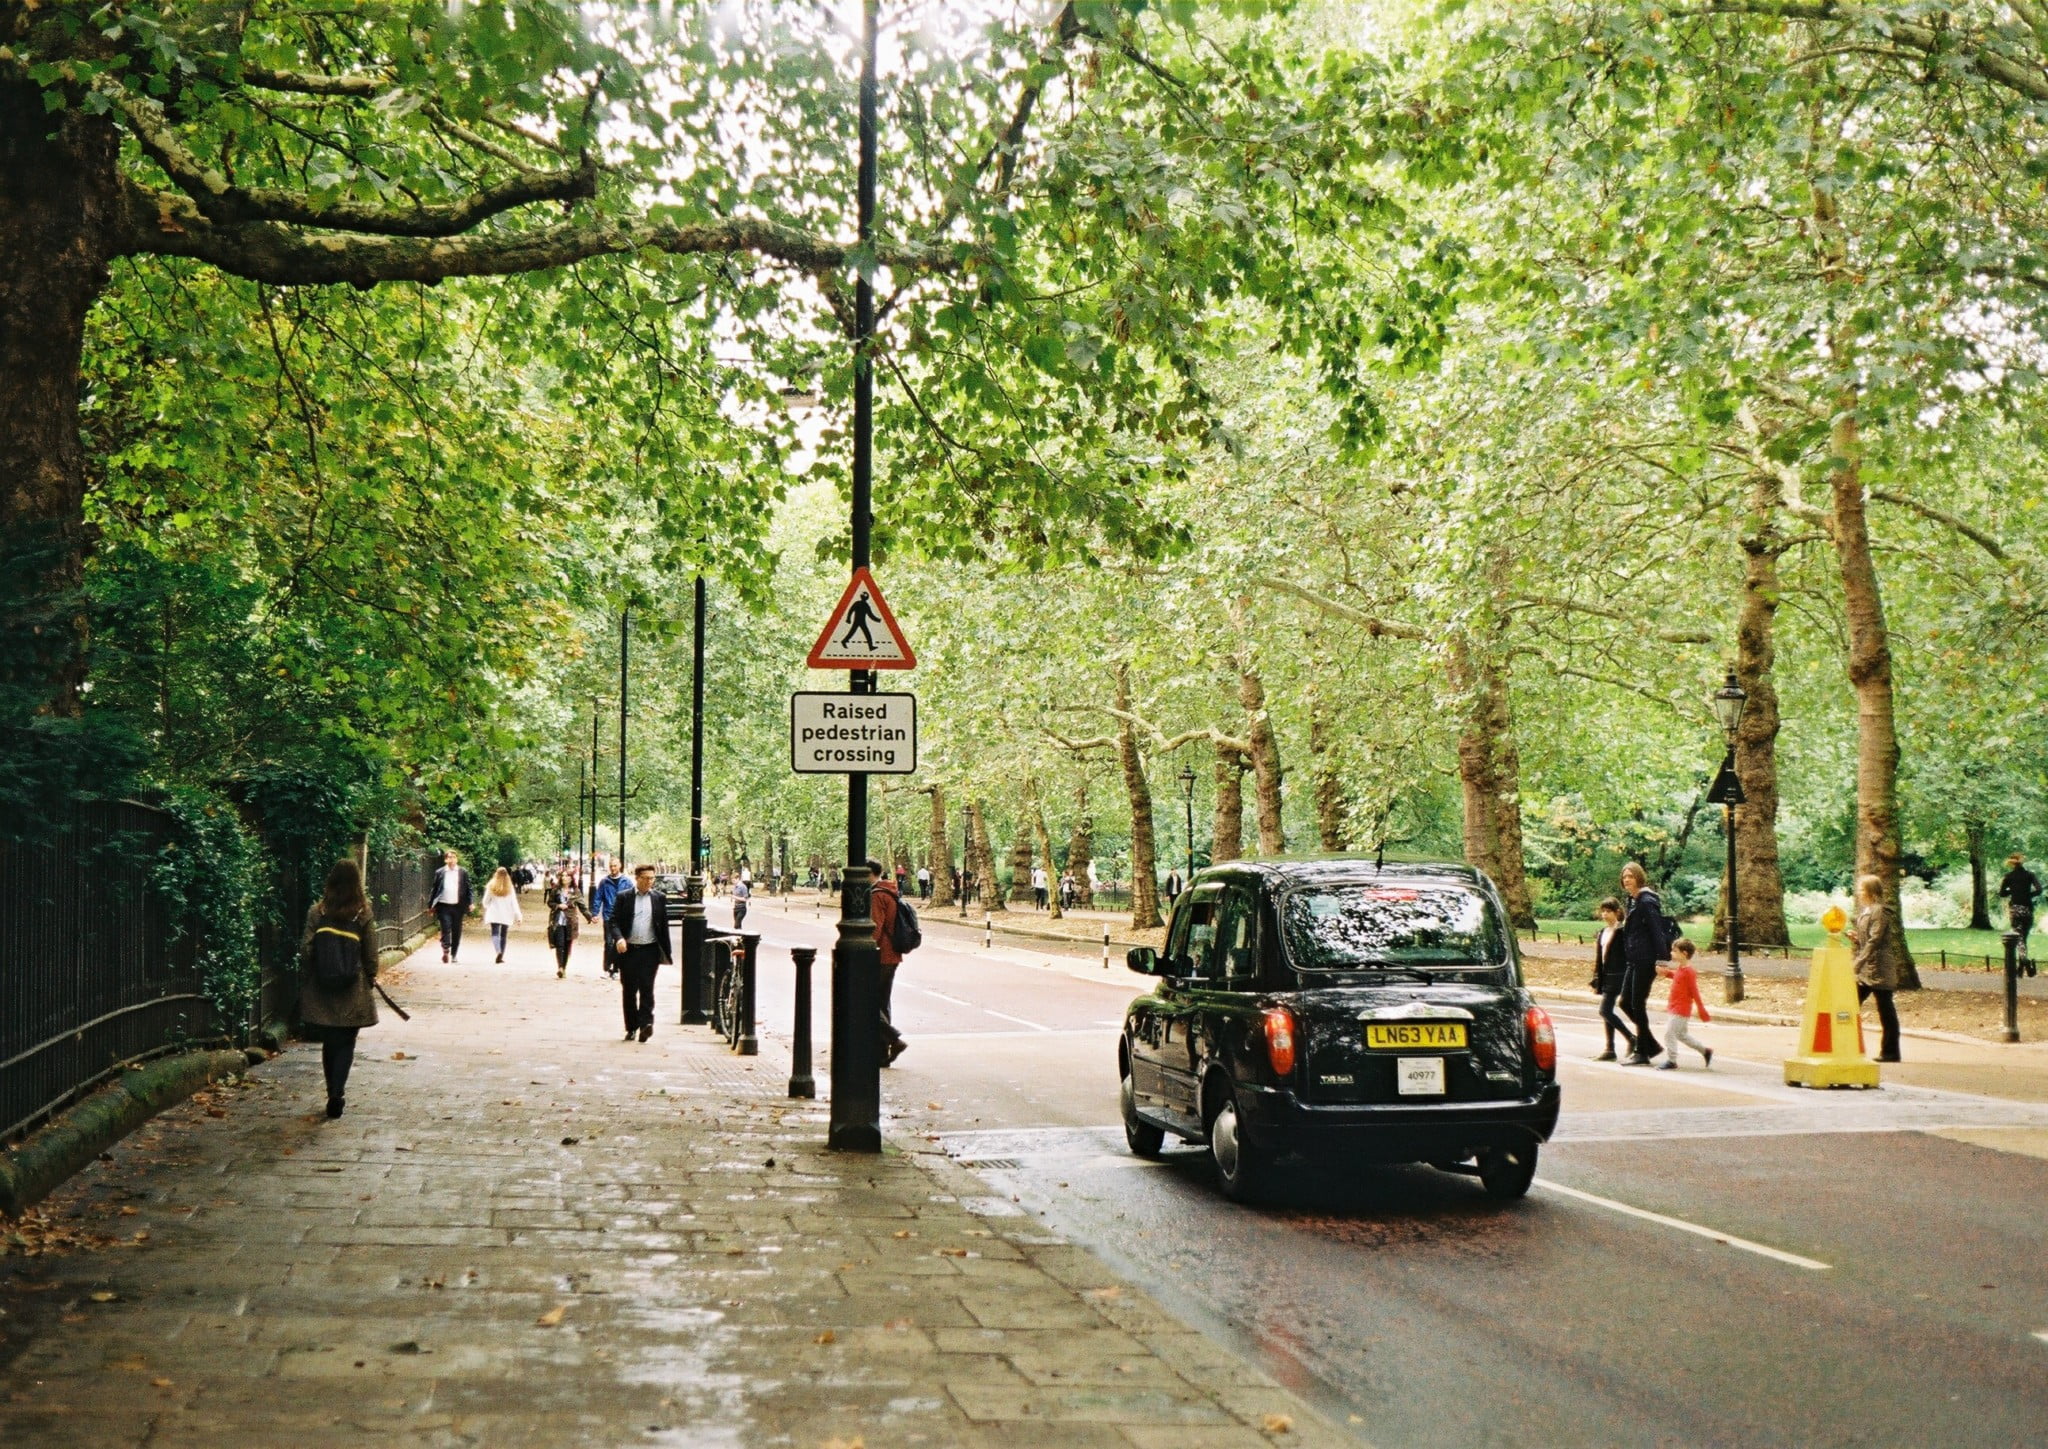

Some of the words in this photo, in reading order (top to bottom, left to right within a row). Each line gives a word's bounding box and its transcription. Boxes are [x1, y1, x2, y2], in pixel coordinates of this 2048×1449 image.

[823, 702, 887, 719] Raised
[802, 724, 906, 743] pedestrian
[814, 747, 895, 765] crossing
[1375, 1027, 1420, 1043] LN63
[1425, 1026, 1457, 1042] YAA
[1408, 1071, 1436, 1080] 40977
